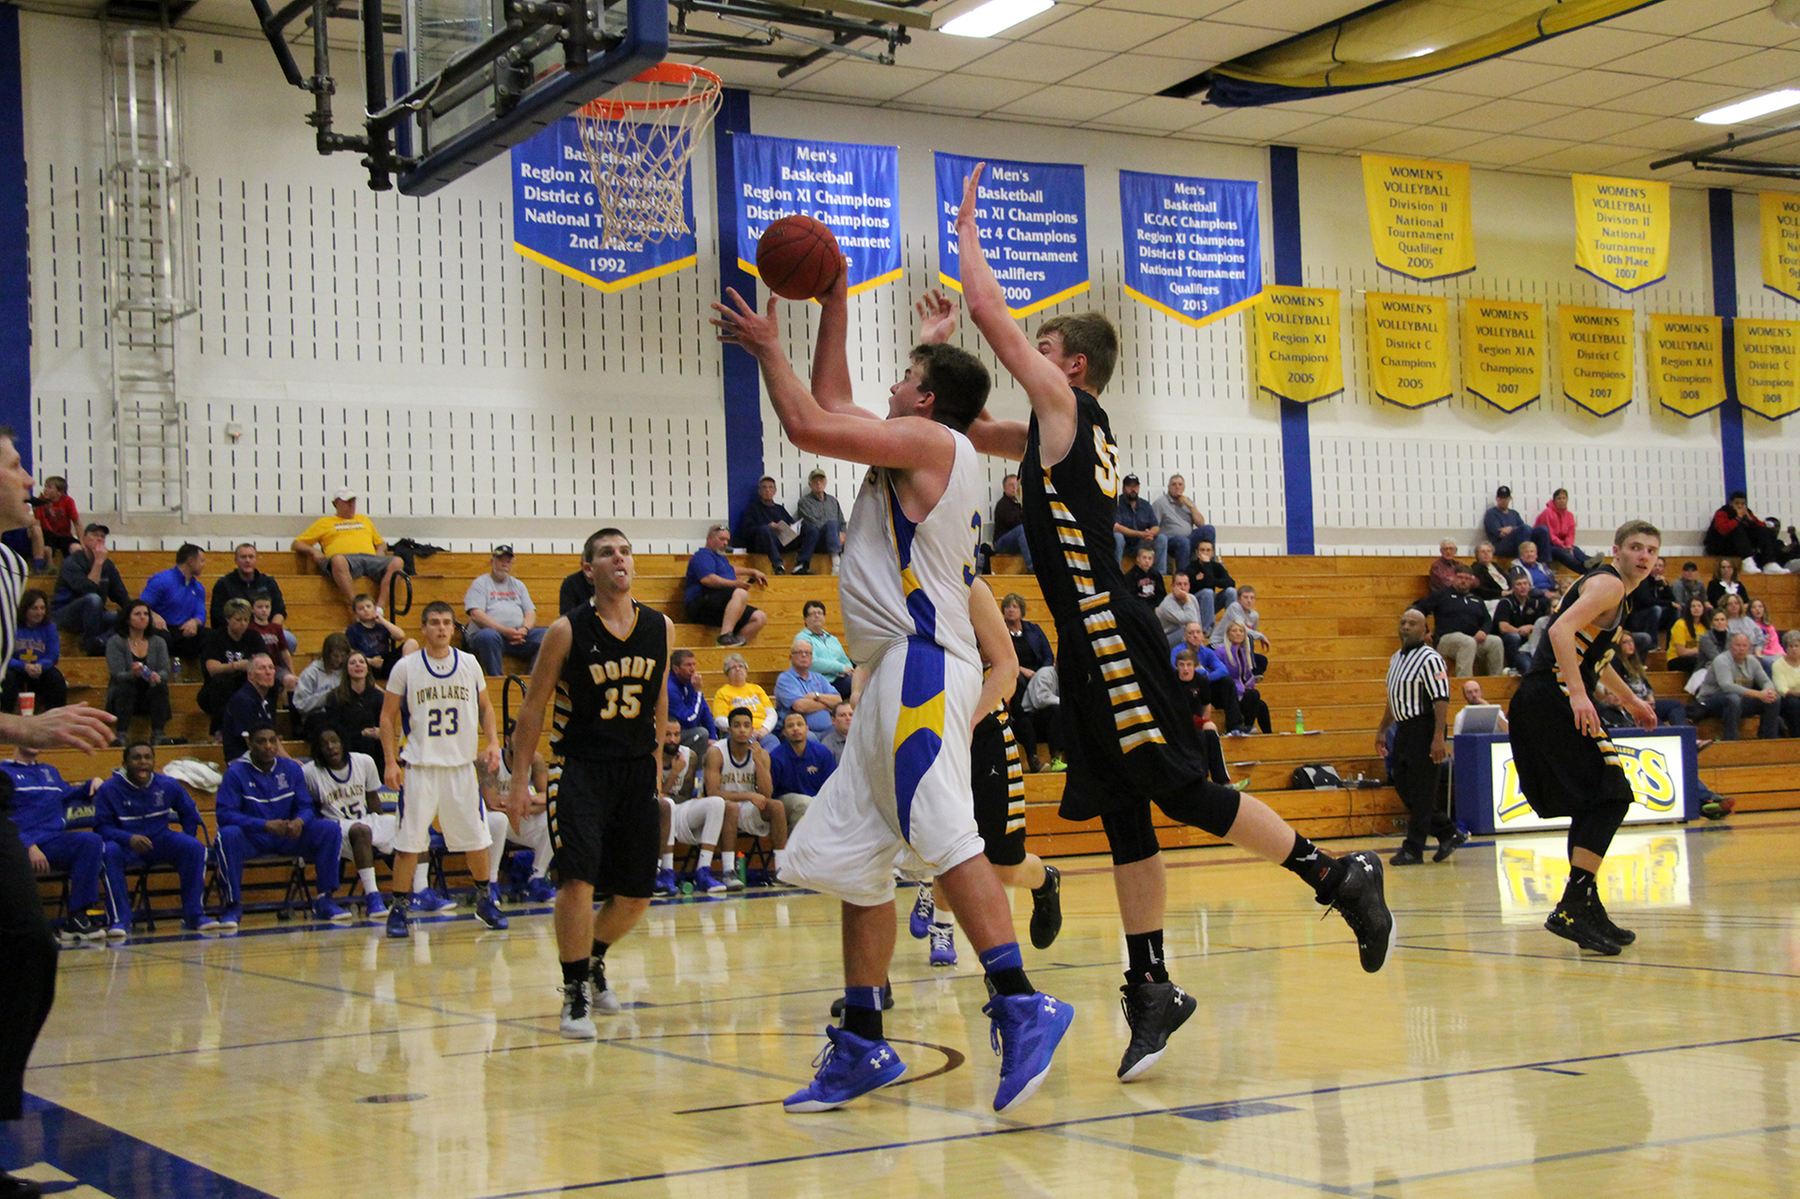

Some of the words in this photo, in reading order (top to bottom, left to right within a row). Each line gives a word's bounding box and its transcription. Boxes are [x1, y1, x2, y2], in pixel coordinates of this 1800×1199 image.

[581, 126, 626, 143] Men's
[797, 147, 838, 163] Men's
[521, 163, 575, 184] Region
[781, 166, 853, 185] Basketball
[992, 167, 1029, 182] Men's
[1390, 166, 1443, 180] WOMEN'S
[524, 185, 580, 204] District
[584, 192, 594, 206] 6
[977, 185, 1043, 203] Basketball
[1174, 183, 1205, 196] Men's
[1384, 181, 1450, 197] VOLLEYBALL
[1597, 185, 1646, 198] WOMEN'S
[743, 183, 792, 203] Region
[797, 188, 811, 203] XI
[815, 189, 891, 210] Champions
[1163, 198, 1217, 213] Basketball
[1390, 197, 1434, 211] Division
[1592, 198, 1652, 213] VOLLEYBALL
[524, 207, 590, 228] National
[813, 210, 890, 229] Champions
[944, 201, 987, 219] Reon
[991, 206, 1004, 220] XI
[1008, 208, 1078, 226] Champions
[1597, 212, 1638, 225] Division
[1144, 212, 1178, 227] ICCAC
[1181, 216, 1238, 232] Champions
[1396, 214, 1443, 228] National
[995, 227, 1004, 240] 4
[1007, 227, 1077, 245] Champions
[1137, 229, 1173, 244] Region
[1176, 233, 1186, 244] XI
[1189, 234, 1245, 248] Champions
[1387, 226, 1454, 241] Tournament
[1602, 227, 1646, 240] National
[569, 233, 598, 250] 2nd
[604, 236, 643, 252] Place
[1398, 241, 1443, 255] Qualifier
[1594, 239, 1655, 254] Tournament
[1003, 246, 1078, 262] Tournament
[1139, 246, 1176, 260] District
[1178, 249, 1186, 261] 8
[1188, 250, 1245, 264] Champions
[1603, 254, 1623, 264] 10th
[1625, 256, 1649, 267] Place
[590, 257, 626, 273] 1992
[1407, 257, 1434, 269] 2005
[1140, 262, 1182, 277] National
[1185, 266, 1245, 279] Tournament
[1615, 268, 1637, 279] 2007
[1169, 282, 1220, 295] Qualifiers
[1183, 299, 1208, 311] 2013
[1271, 294, 1324, 307] WOMEN'S
[1382, 301, 1432, 314] WOMEN'S
[1265, 312, 1331, 325] VOLLEYBALL
[1480, 308, 1529, 321] WOMEN'S
[1573, 314, 1620, 326] WOMEN'S
[1377, 319, 1438, 332] VOLLEYBALL
[1476, 325, 1536, 339] VOLLEYBALL
[1664, 322, 1709, 334] WOMEN'S
[1747, 326, 1791, 337] WOMEN'S
[1273, 332, 1309, 345] Region
[1314, 334, 1326, 343] XI
[1386, 337, 1421, 350] District
[1425, 340, 1432, 350] C
[1569, 332, 1627, 344] VOLLEYBALL
[1478, 343, 1511, 357] Region
[1659, 340, 1713, 351] VOLLEYBALL
[1743, 344, 1796, 355] VOLLEYBALL
[1269, 350, 1328, 365] Champions
[1577, 349, 1609, 360] District
[1614, 351, 1620, 361] C
[1381, 355, 1437, 370] Champions
[1480, 362, 1534, 376] Champions
[1661, 356, 1692, 369] Region
[1749, 361, 1779, 370] District
[1288, 372, 1315, 384] 2005
[1574, 367, 1626, 381] Champions
[1663, 373, 1712, 385] Champions
[1397, 377, 1423, 389] 2005
[1497, 383, 1519, 394] 2007
[1748, 377, 1794, 389] Champions
[1590, 388, 1612, 398] 2007
[588, 655, 656, 685] DORDT
[416, 686, 438, 704] IOWA
[441, 685, 469, 702] LAKES
[600, 684, 643, 719] 35
[428, 707, 458, 737] 23
